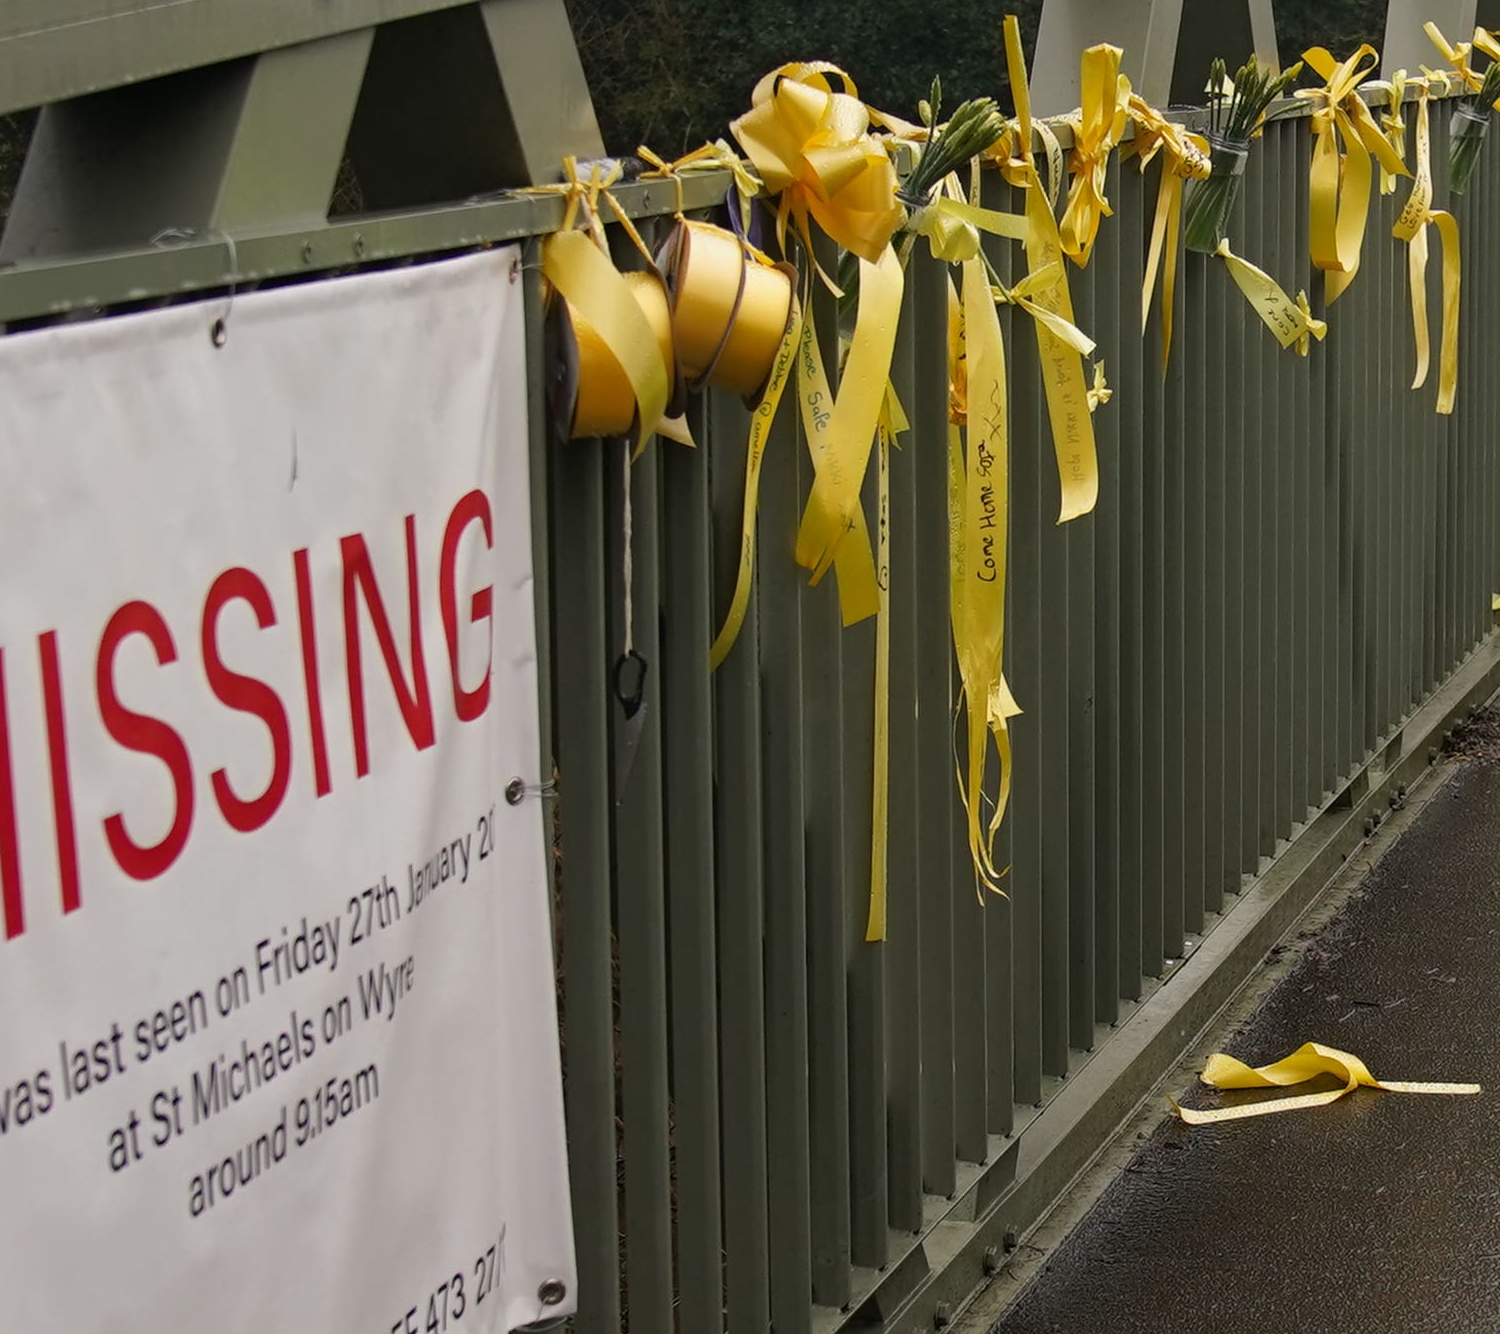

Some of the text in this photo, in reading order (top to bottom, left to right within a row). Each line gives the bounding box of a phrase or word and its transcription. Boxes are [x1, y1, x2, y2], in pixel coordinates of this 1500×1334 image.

[807, 391, 831, 434] Safe
[977, 536, 997, 583] Come
[59, 1022, 128, 1102] last
[134, 990, 208, 1064] seen
[215, 965, 250, 1019] on
[255, 915, 341, 996] Friday
[346, 874, 401, 947] 27th
[406, 832, 472, 915] January
[108, 954, 415, 1173] at St Michaels on Wyre
[189, 1063, 380, 1218] around 9.15am
